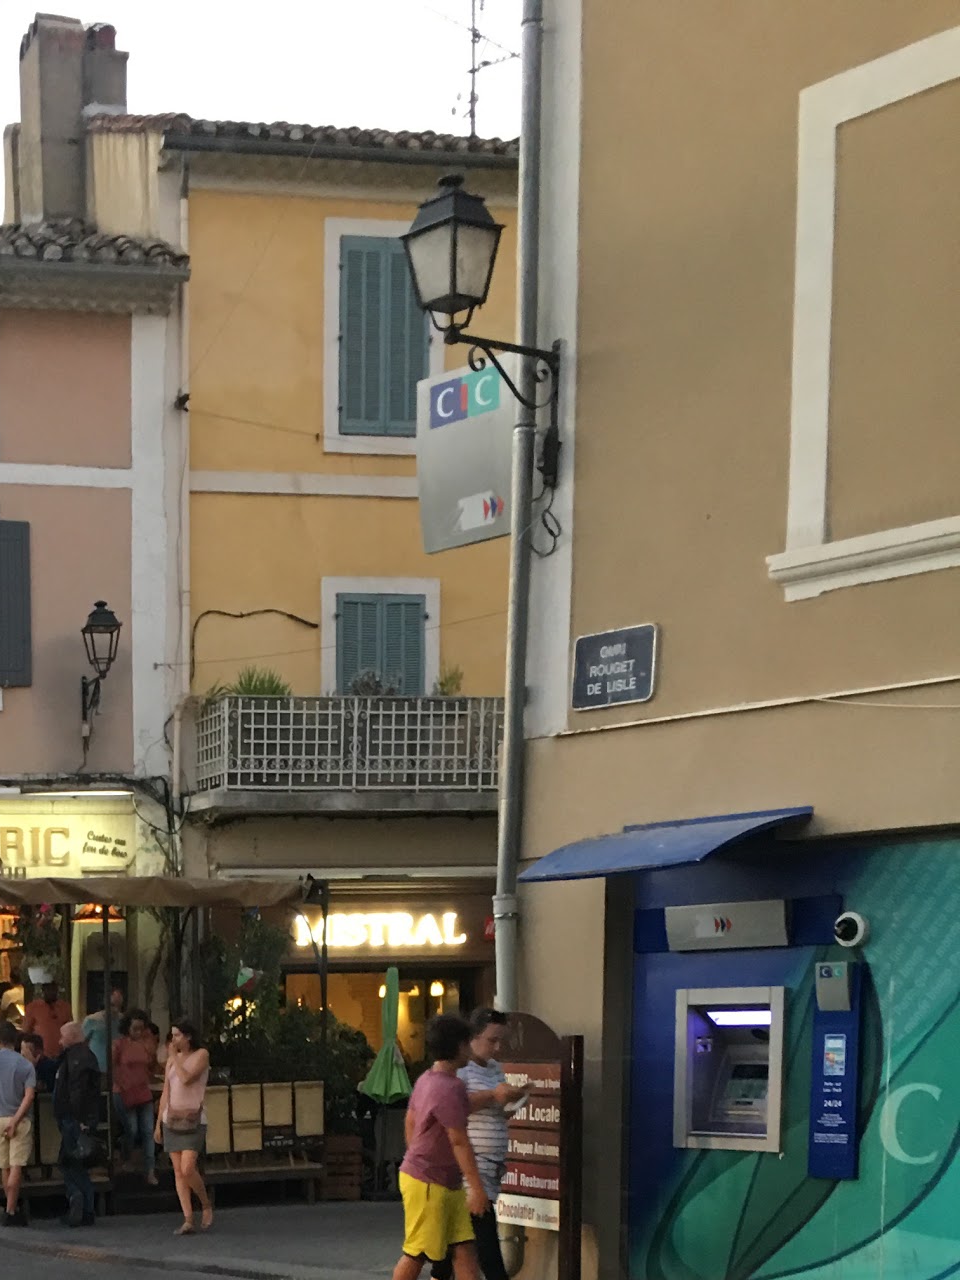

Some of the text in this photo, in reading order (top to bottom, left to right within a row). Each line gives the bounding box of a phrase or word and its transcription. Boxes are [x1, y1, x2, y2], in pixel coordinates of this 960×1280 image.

[589, 659, 635, 678] ROUGET
[587, 683, 602, 696] DE
[295, 912, 467, 946] MISTRAL
[529, 1104, 561, 1123] Locale
[520, 1173, 559, 1191] Restaurant
[498, 1199, 535, 1221] Chocolatier
